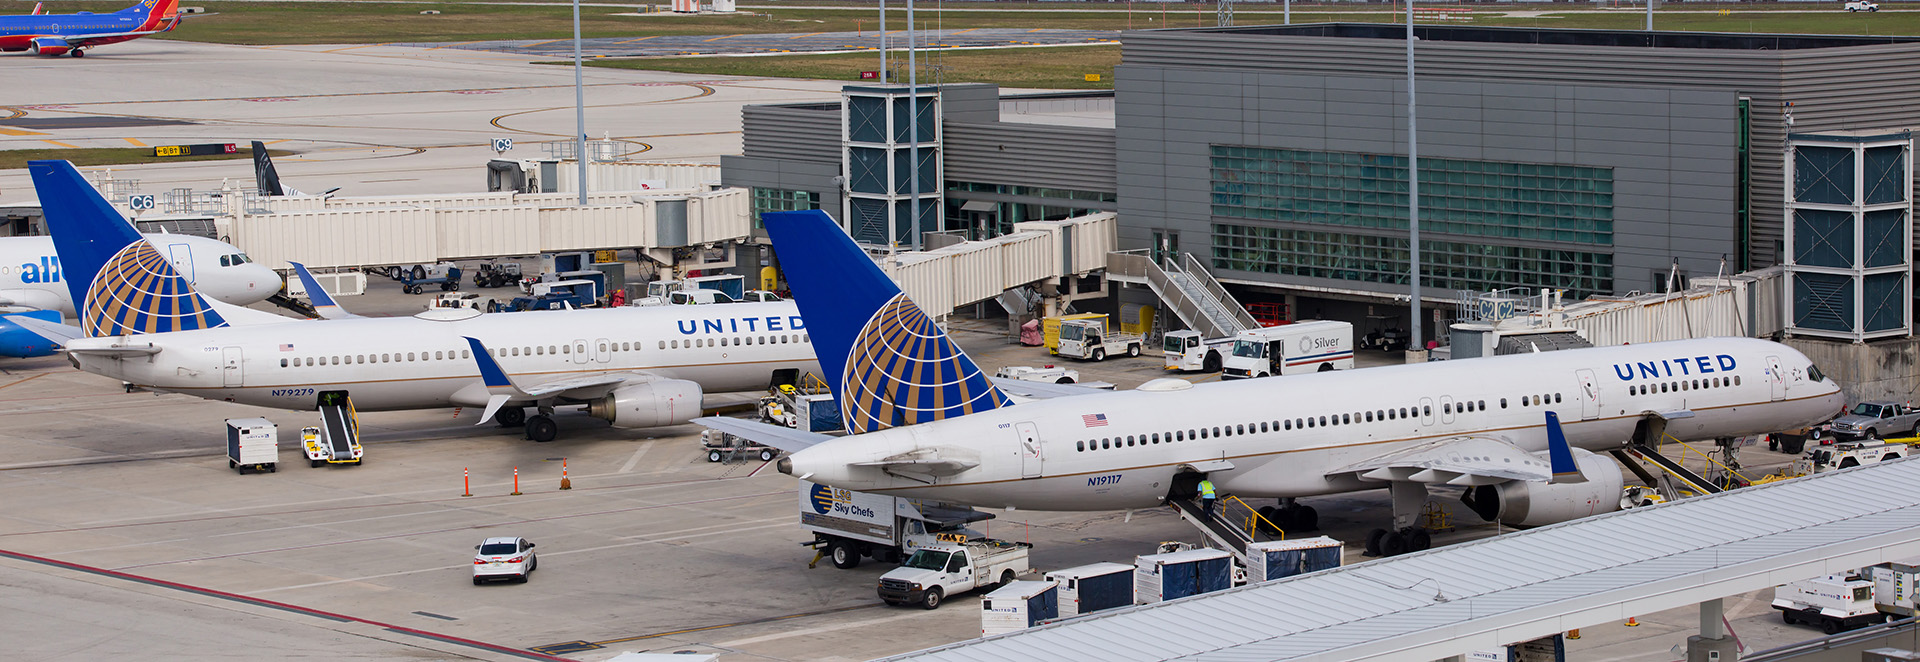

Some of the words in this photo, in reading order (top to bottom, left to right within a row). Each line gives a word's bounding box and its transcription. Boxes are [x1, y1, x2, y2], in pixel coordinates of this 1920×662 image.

[496, 139, 511, 151] C9
[131, 195, 153, 209] C6
[21, 256, 66, 283] all
[1480, 300, 1494, 319] C2
[1498, 301, 1513, 320] C2
[677, 315, 806, 335] UNITED
[1314, 337, 1340, 349] Silver
[1613, 354, 1737, 381] UNITED
[272, 388, 315, 397] N79279
[1087, 474, 1122, 487] N19117
[834, 488, 851, 500] LSG
[834, 502, 850, 515] Sky
[850, 505, 875, 518] Chefs
